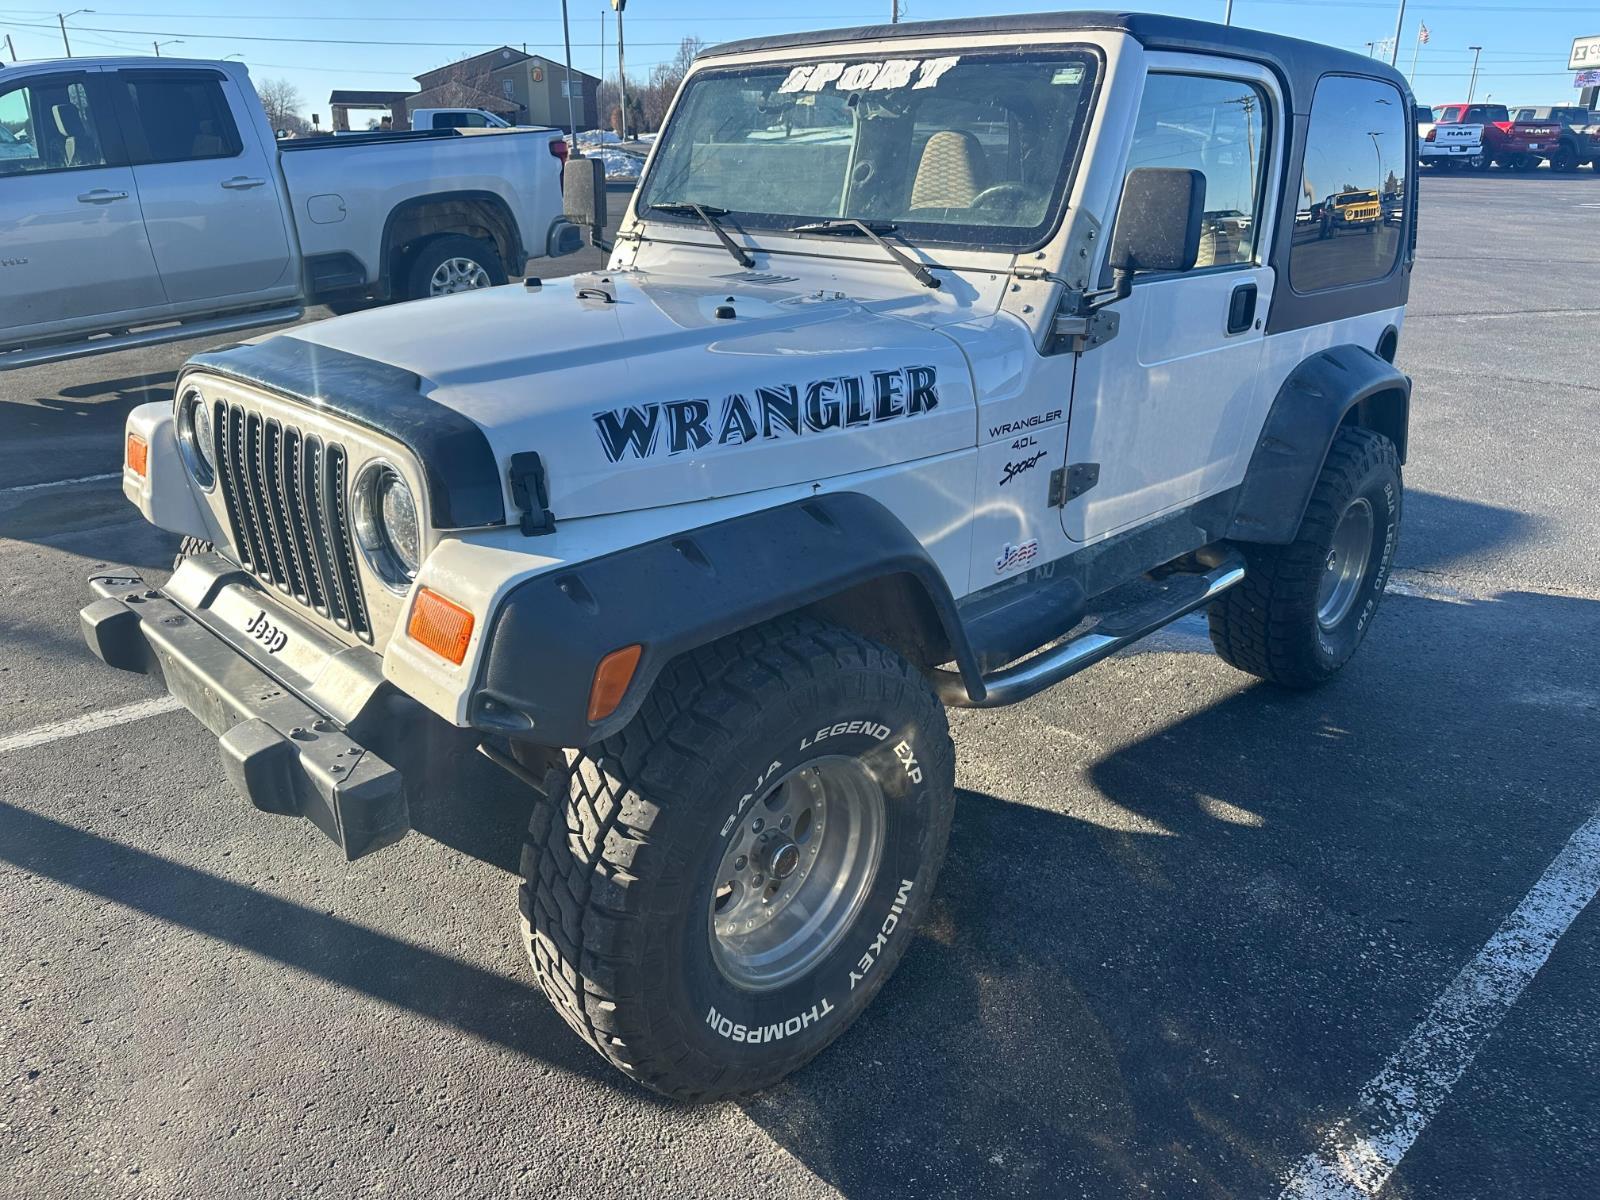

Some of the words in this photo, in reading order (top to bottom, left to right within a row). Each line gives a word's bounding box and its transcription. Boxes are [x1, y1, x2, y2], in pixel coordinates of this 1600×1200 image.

[777, 55, 961, 94] SPORT
[591, 364, 940, 464] WRANGLER
[988, 409, 1063, 438] WRANGLER
[1383, 483, 1396, 516] BAJA
[1373, 523, 1396, 591] LEGEND
[245, 610, 288, 654] Jeep
[719, 760, 783, 838] BAJA
[799, 720, 892, 752] LEGEND
[892, 739, 924, 785] EXP
[848, 878, 914, 991] MICKEY
[704, 997, 836, 1045] THOMPSON
